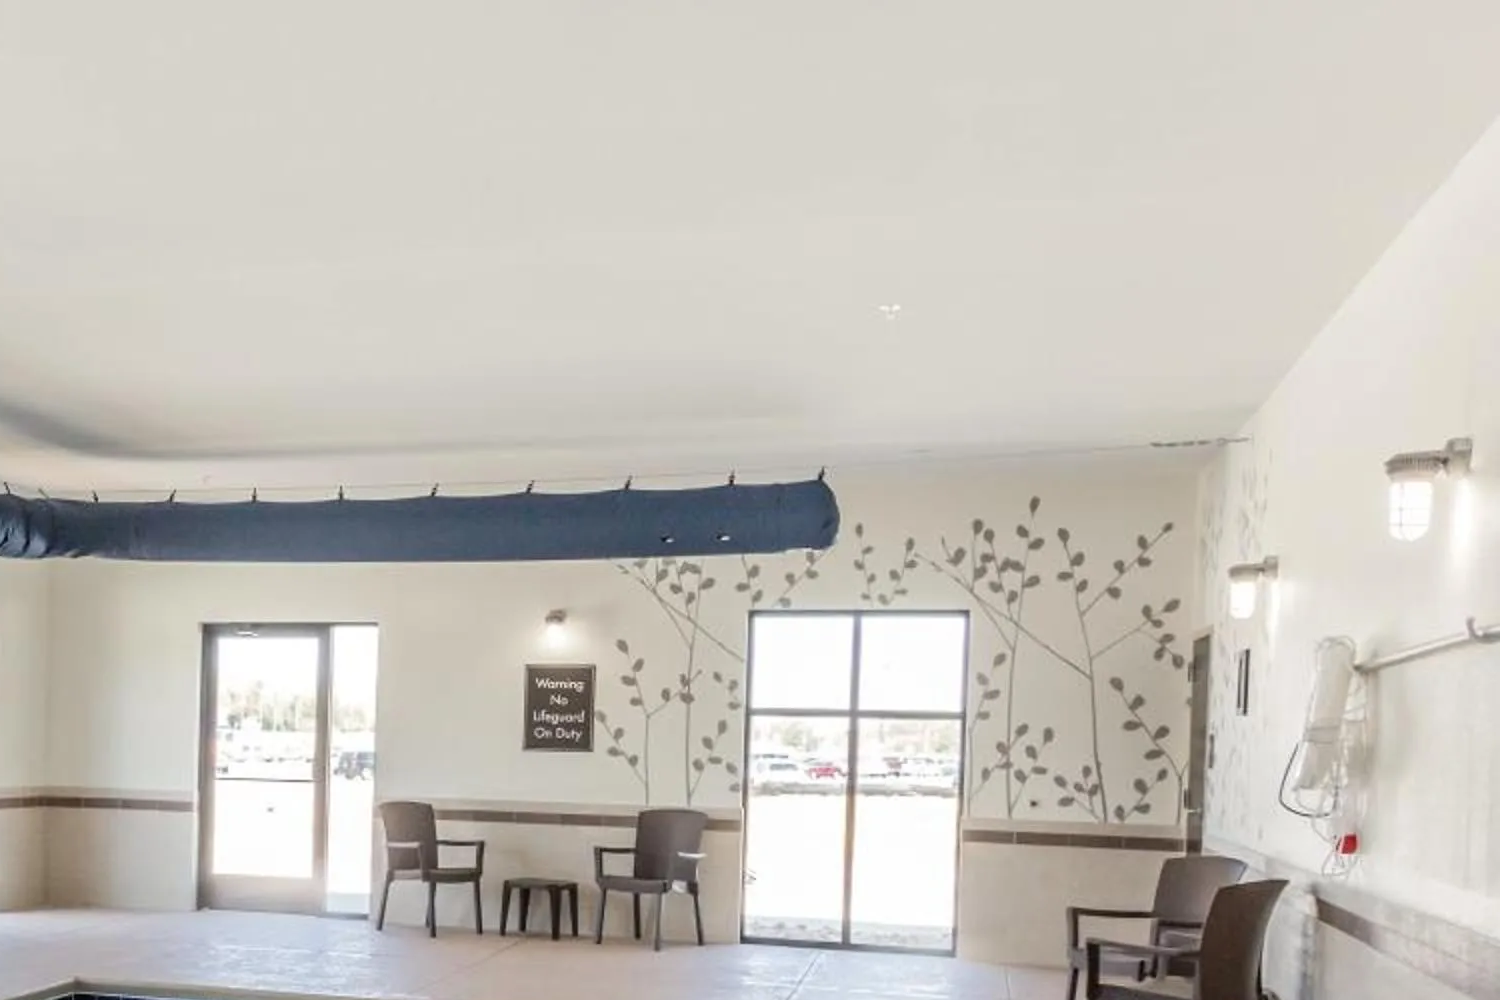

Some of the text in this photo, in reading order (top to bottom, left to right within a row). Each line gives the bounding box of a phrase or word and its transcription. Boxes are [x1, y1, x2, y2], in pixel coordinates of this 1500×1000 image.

[535, 677, 585, 693] Warning
[549, 694, 569, 706] No
[532, 709, 586, 725] Lifeguard
[533, 727, 582, 742] On Duty
